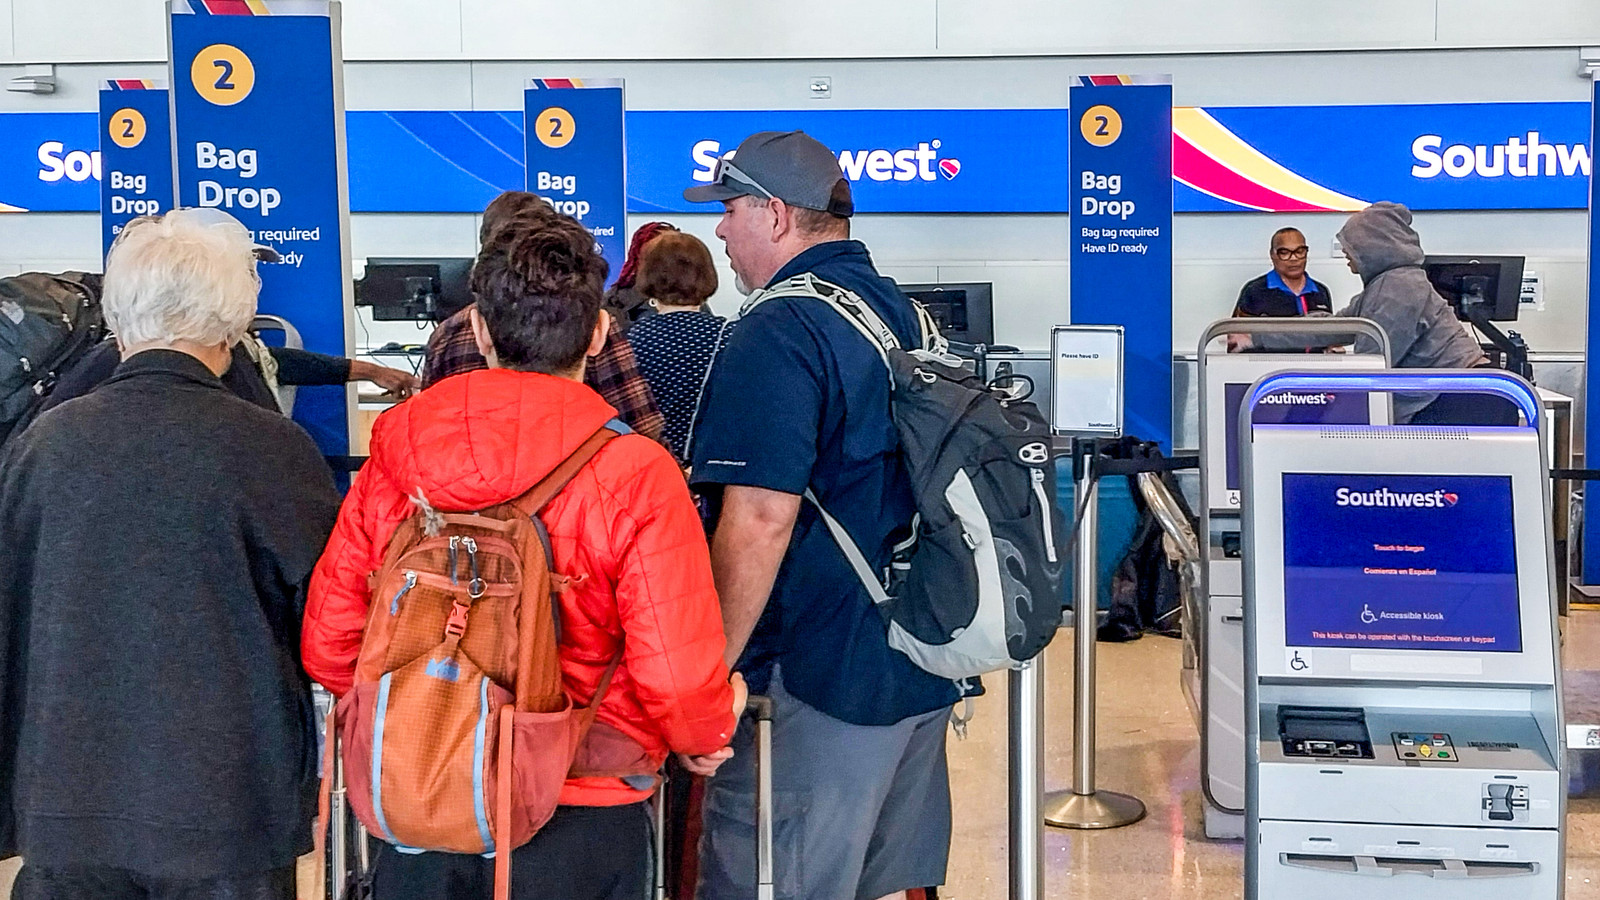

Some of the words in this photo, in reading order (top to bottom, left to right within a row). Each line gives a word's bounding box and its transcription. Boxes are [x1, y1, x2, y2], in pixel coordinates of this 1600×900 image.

[212, 60, 235, 90] 2
[121, 118, 135, 138] 2
[549, 117, 563, 138] 2
[1094, 115, 1109, 136] 2
[196, 141, 258, 178] Bag
[110, 171, 147, 194] Bag
[537, 171, 576, 195] Bag
[1081, 171, 1121, 195] Bag
[111, 196, 160, 216] Drop
[198, 180, 281, 217] Drop
[1081, 197, 1136, 220] Drop
[259, 226, 320, 244] required
[1081, 227, 1100, 239] Bag
[1102, 228, 1117, 239] tag
[1119, 226, 1159, 239] required
[1081, 242, 1106, 253] Have
[1108, 243, 1119, 253] ID
[1121, 242, 1148, 255] ready
[1336, 487, 1445, 508] Southwest
[1380, 610, 1422, 620] Accessible
[1423, 611, 1444, 620] kiosk
[1312, 631, 1326, 639] This
